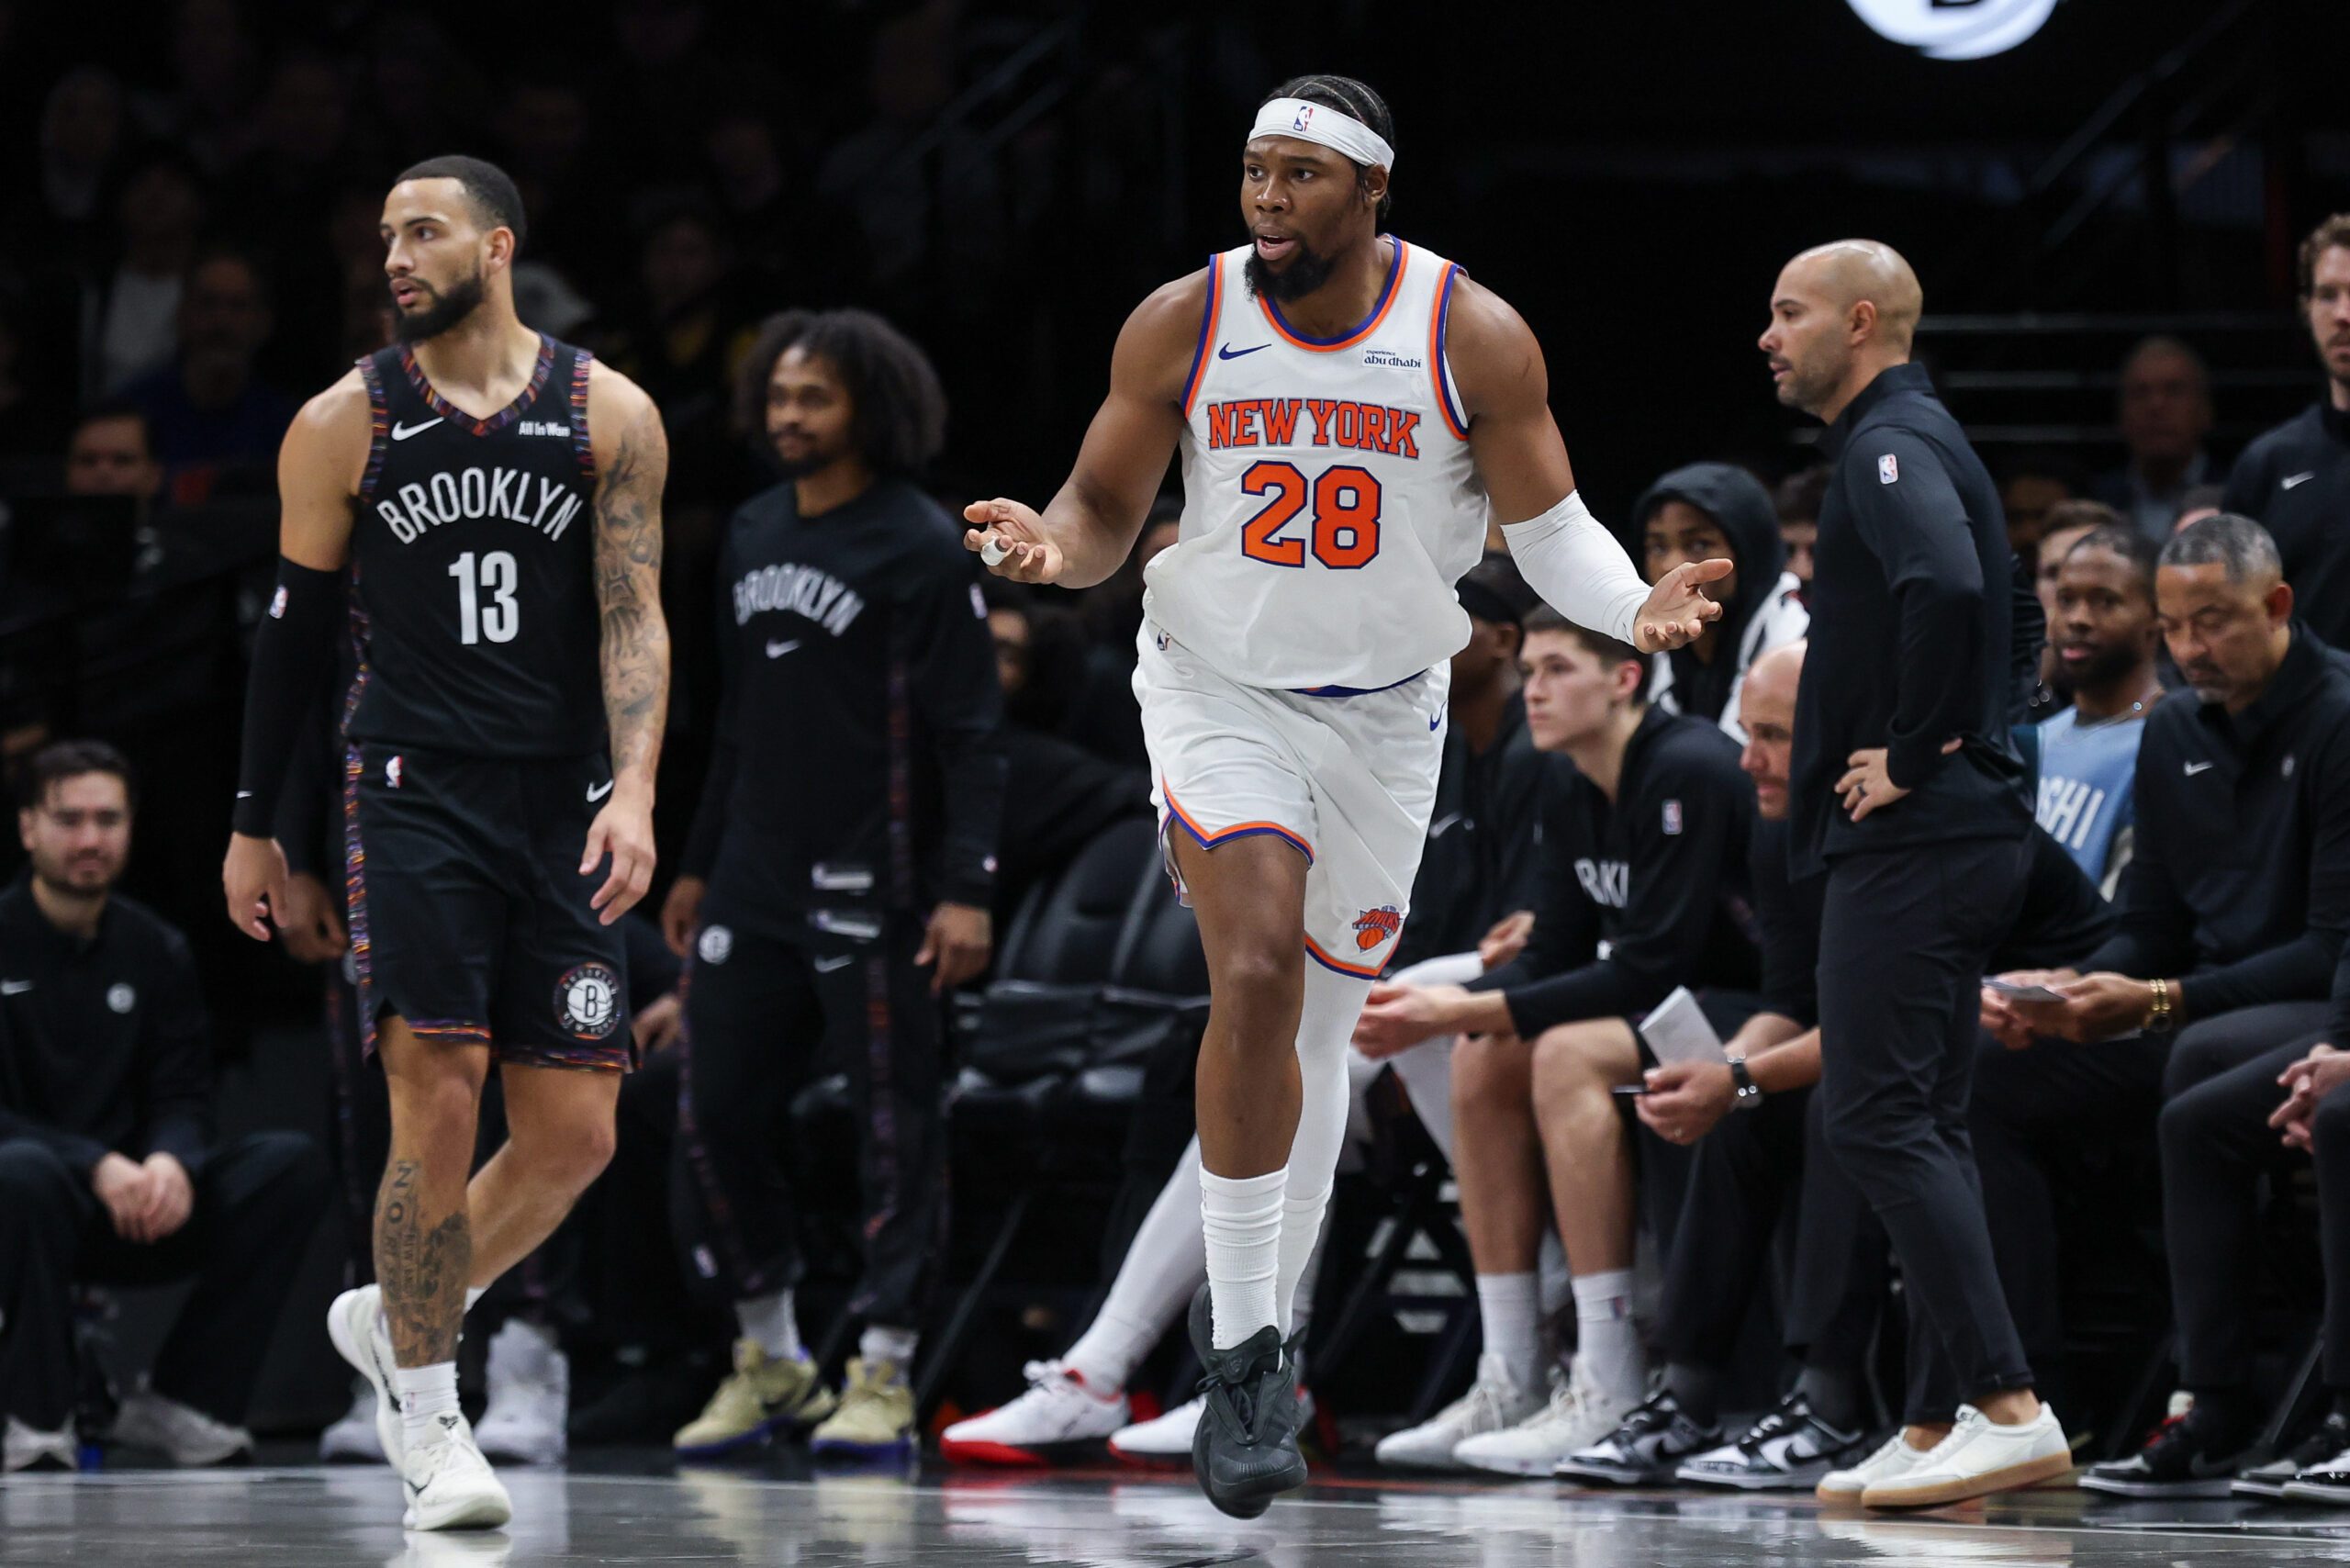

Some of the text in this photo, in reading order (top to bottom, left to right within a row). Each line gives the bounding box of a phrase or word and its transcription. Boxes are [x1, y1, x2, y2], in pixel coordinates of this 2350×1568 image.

[1364, 355, 1422, 368] abu dhabi
[1207, 398, 1421, 460] NEW YORK
[376, 466, 584, 544] BROOKLYN
[1241, 460, 1382, 570] 28
[448, 551, 520, 644] 13
[733, 562, 865, 637] BROOKLYN
[585, 985, 598, 1018] B
